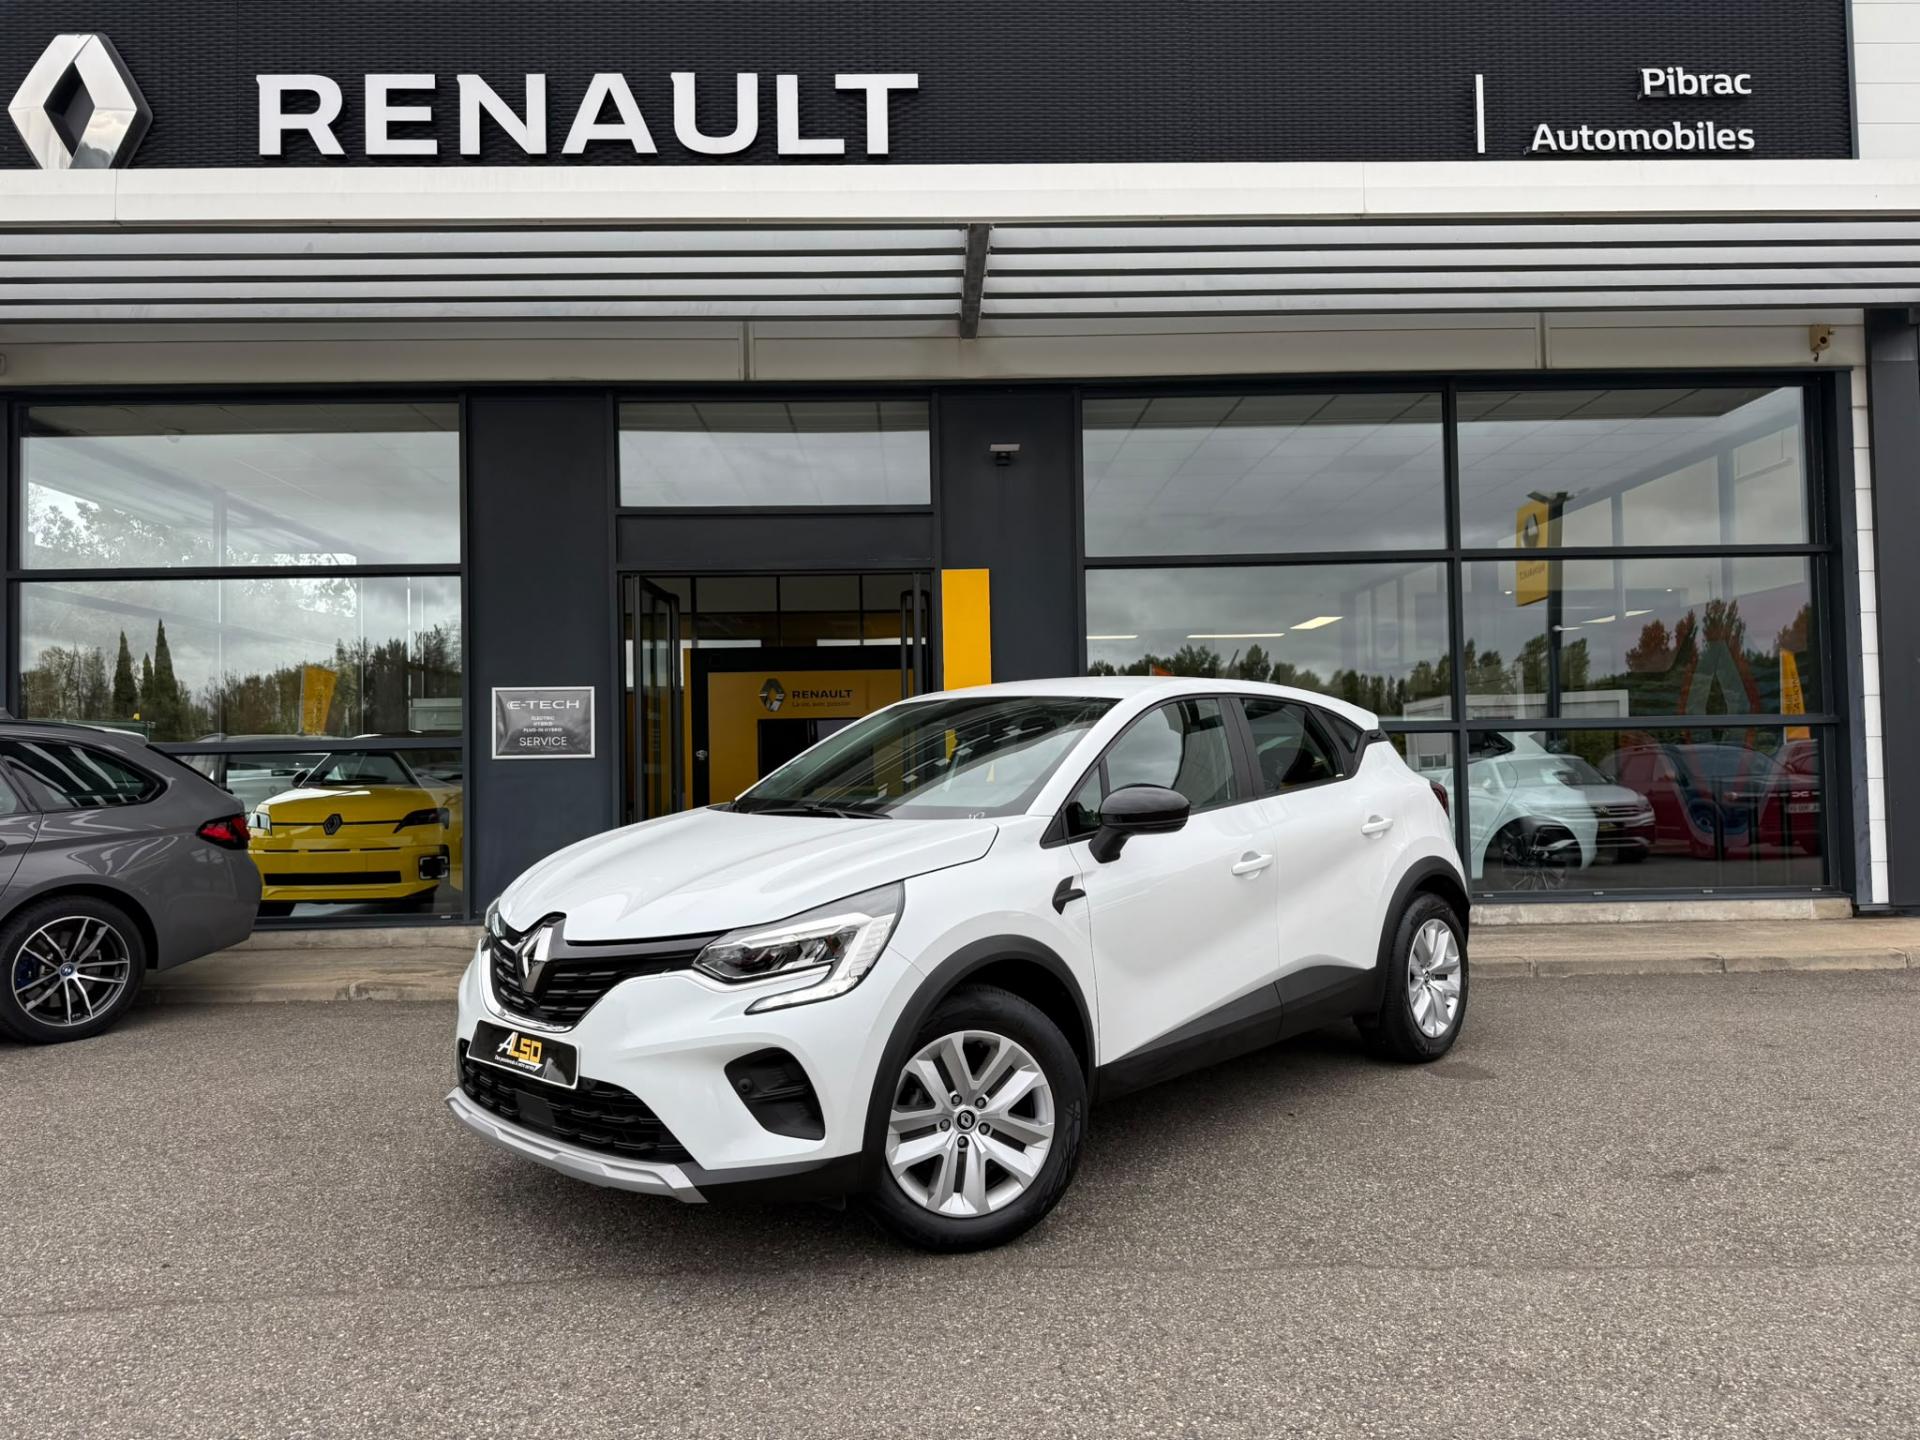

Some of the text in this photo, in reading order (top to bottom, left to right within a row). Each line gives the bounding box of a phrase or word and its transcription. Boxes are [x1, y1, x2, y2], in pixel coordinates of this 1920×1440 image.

[1641, 67, 1753, 95] Pibrac
[256, 72, 920, 158] RENAULT
[1531, 121, 1755, 151] Automobiles
[791, 689, 853, 699] RENAULT
[506, 699, 580, 710] E-TECH
[519, 736, 568, 747] SERVICE
